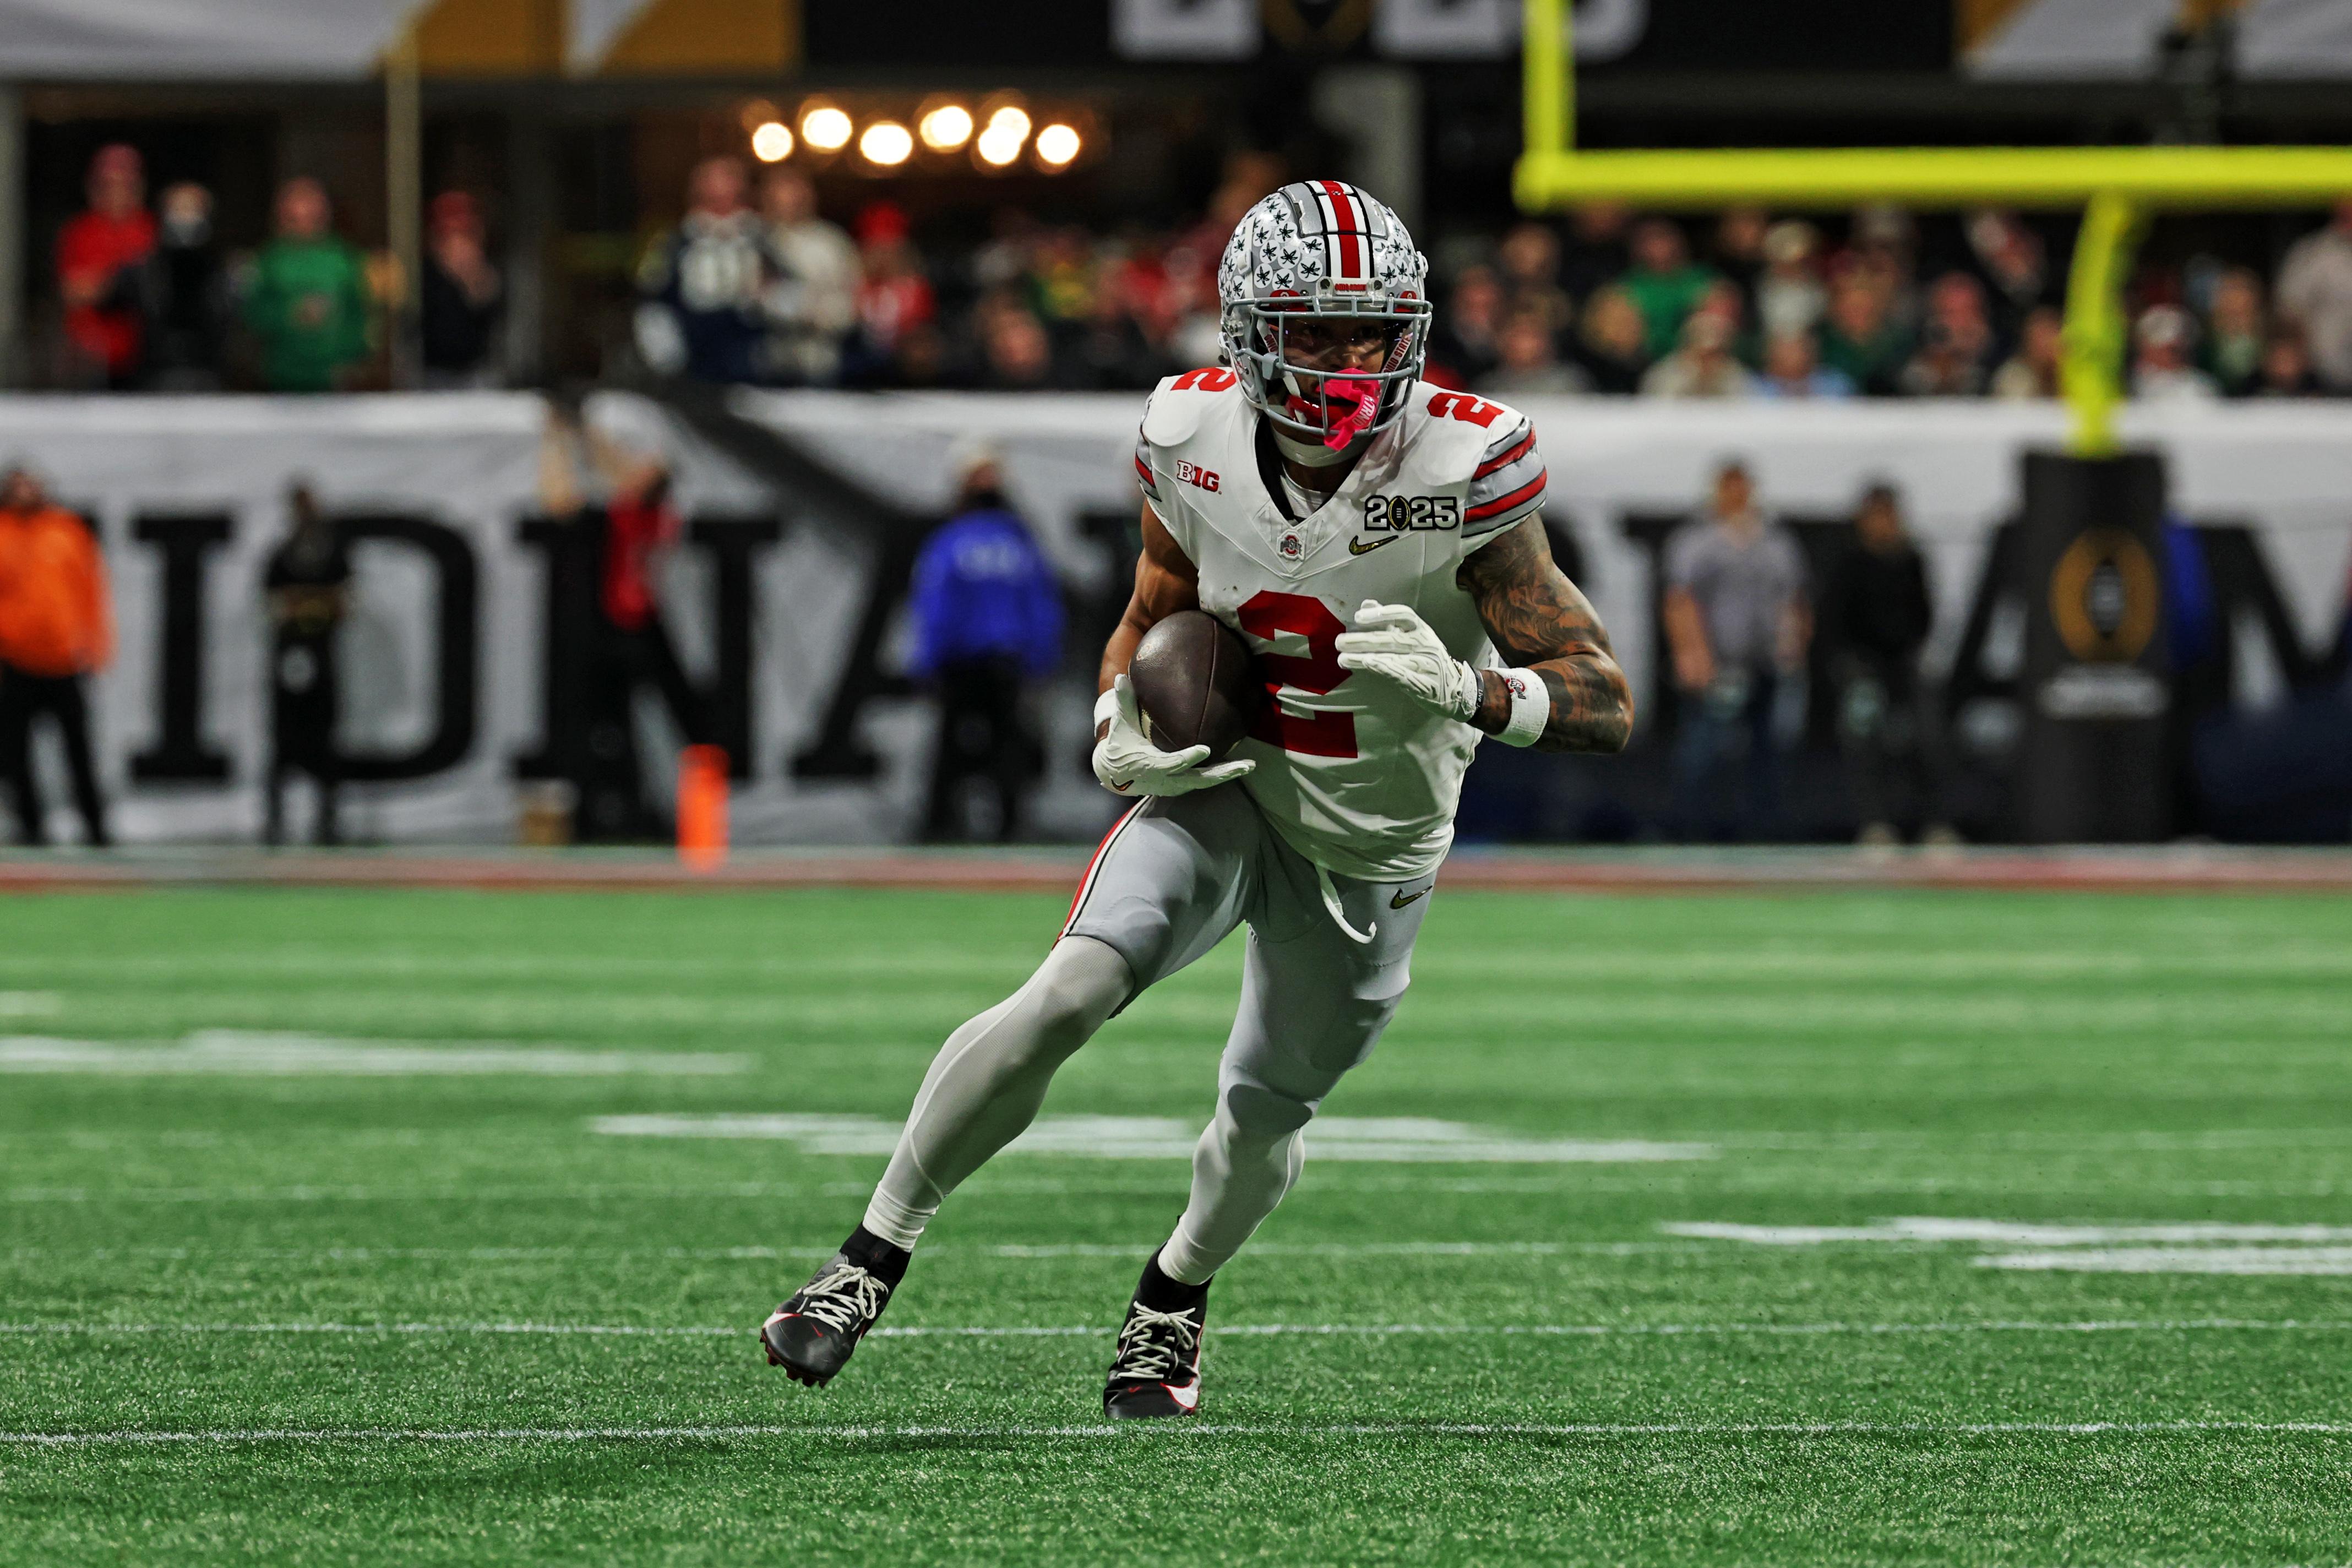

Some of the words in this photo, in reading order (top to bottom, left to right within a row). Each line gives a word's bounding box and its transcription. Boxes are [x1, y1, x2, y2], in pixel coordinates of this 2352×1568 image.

[1170, 367, 1237, 391] 2
[1427, 393, 1505, 428] 2
[1364, 496, 1459, 530] 2025
[1237, 590, 1358, 758] 2
